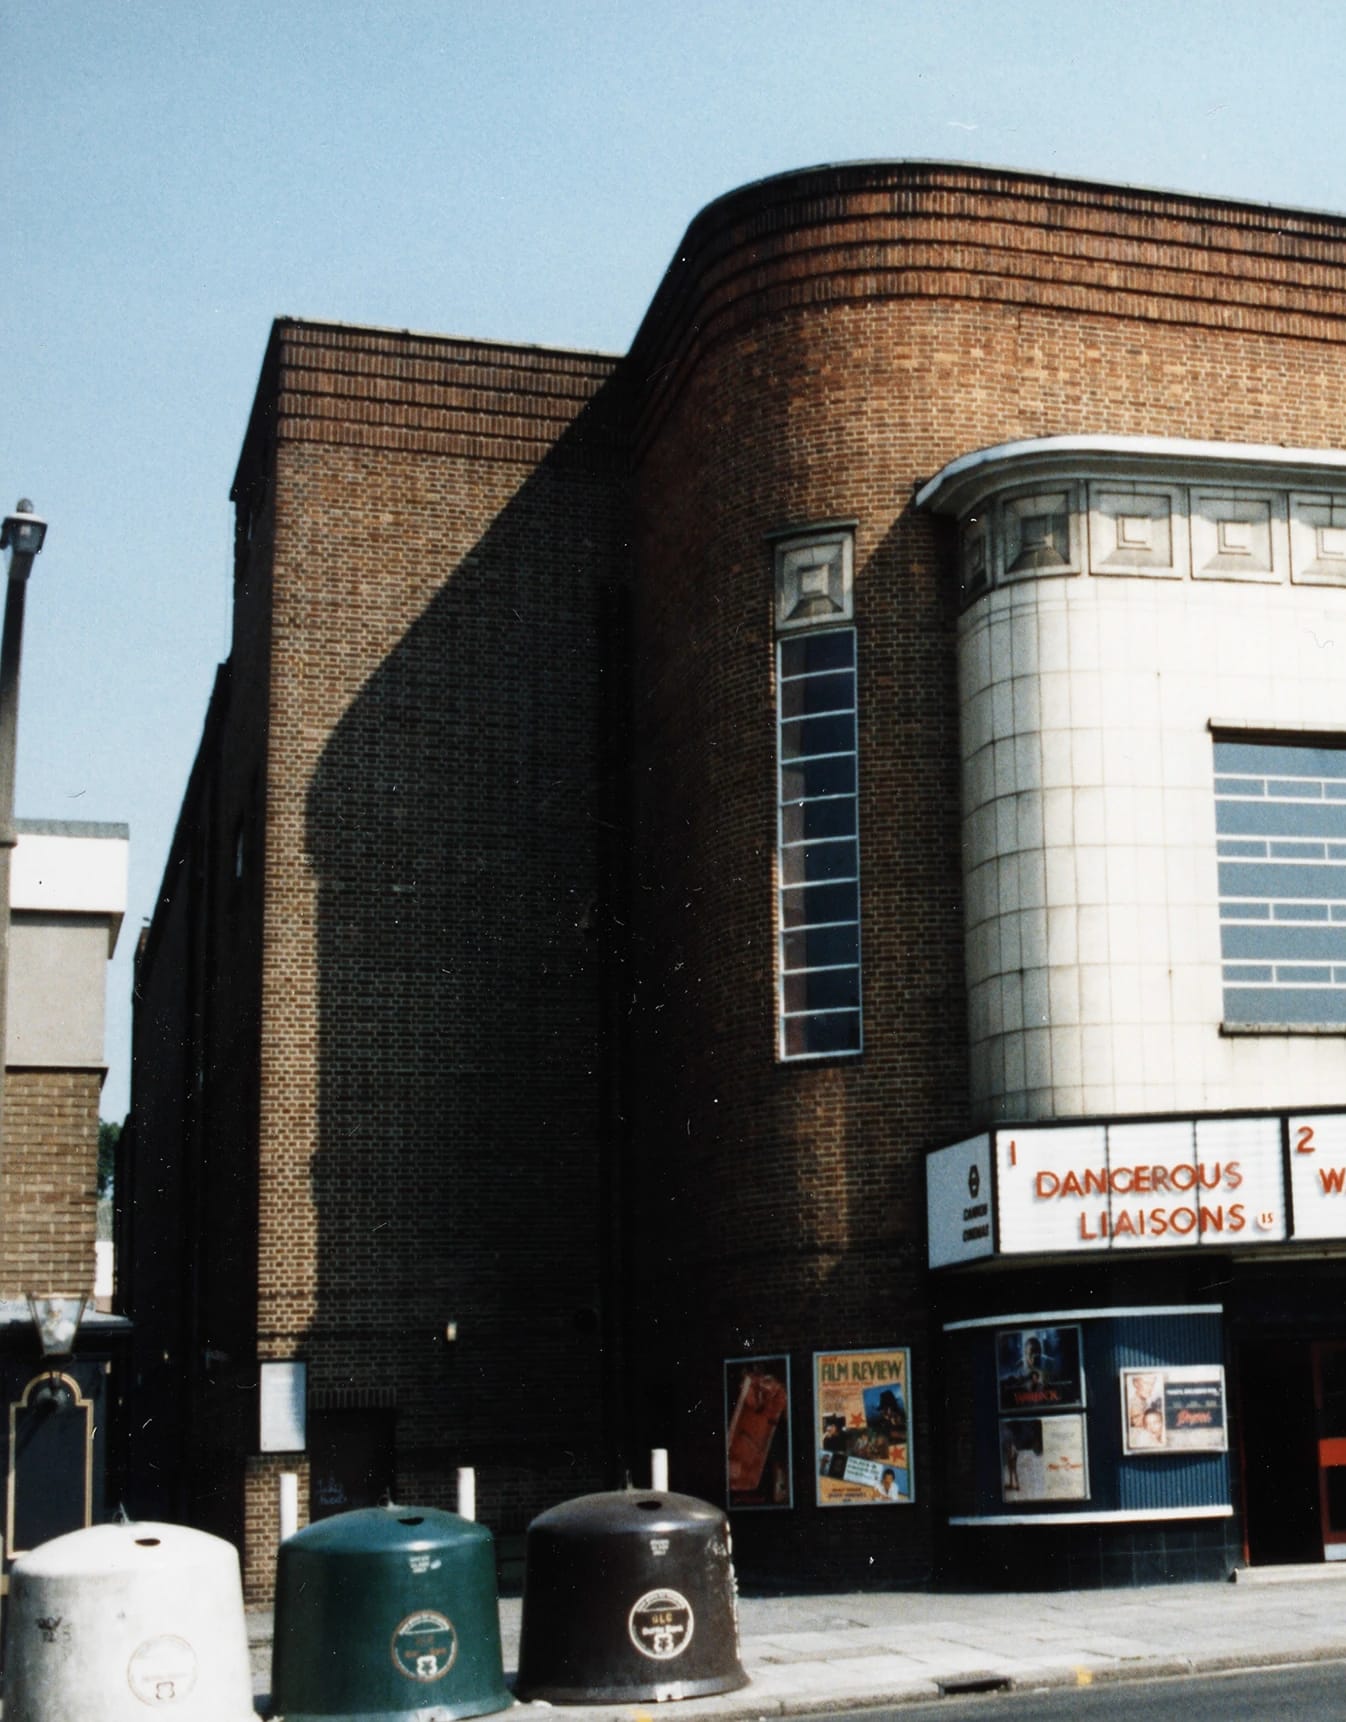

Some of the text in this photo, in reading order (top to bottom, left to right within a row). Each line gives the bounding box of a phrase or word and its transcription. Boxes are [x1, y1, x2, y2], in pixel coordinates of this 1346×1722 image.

[1009, 1140, 1017, 1166] 1
[1296, 1126, 1316, 1155] 2
[1034, 1161, 1243, 1198] DANGEROUS
[1079, 1203, 1246, 1240] LIAISONS
[821, 1359, 902, 1382] FILM REVIEW
